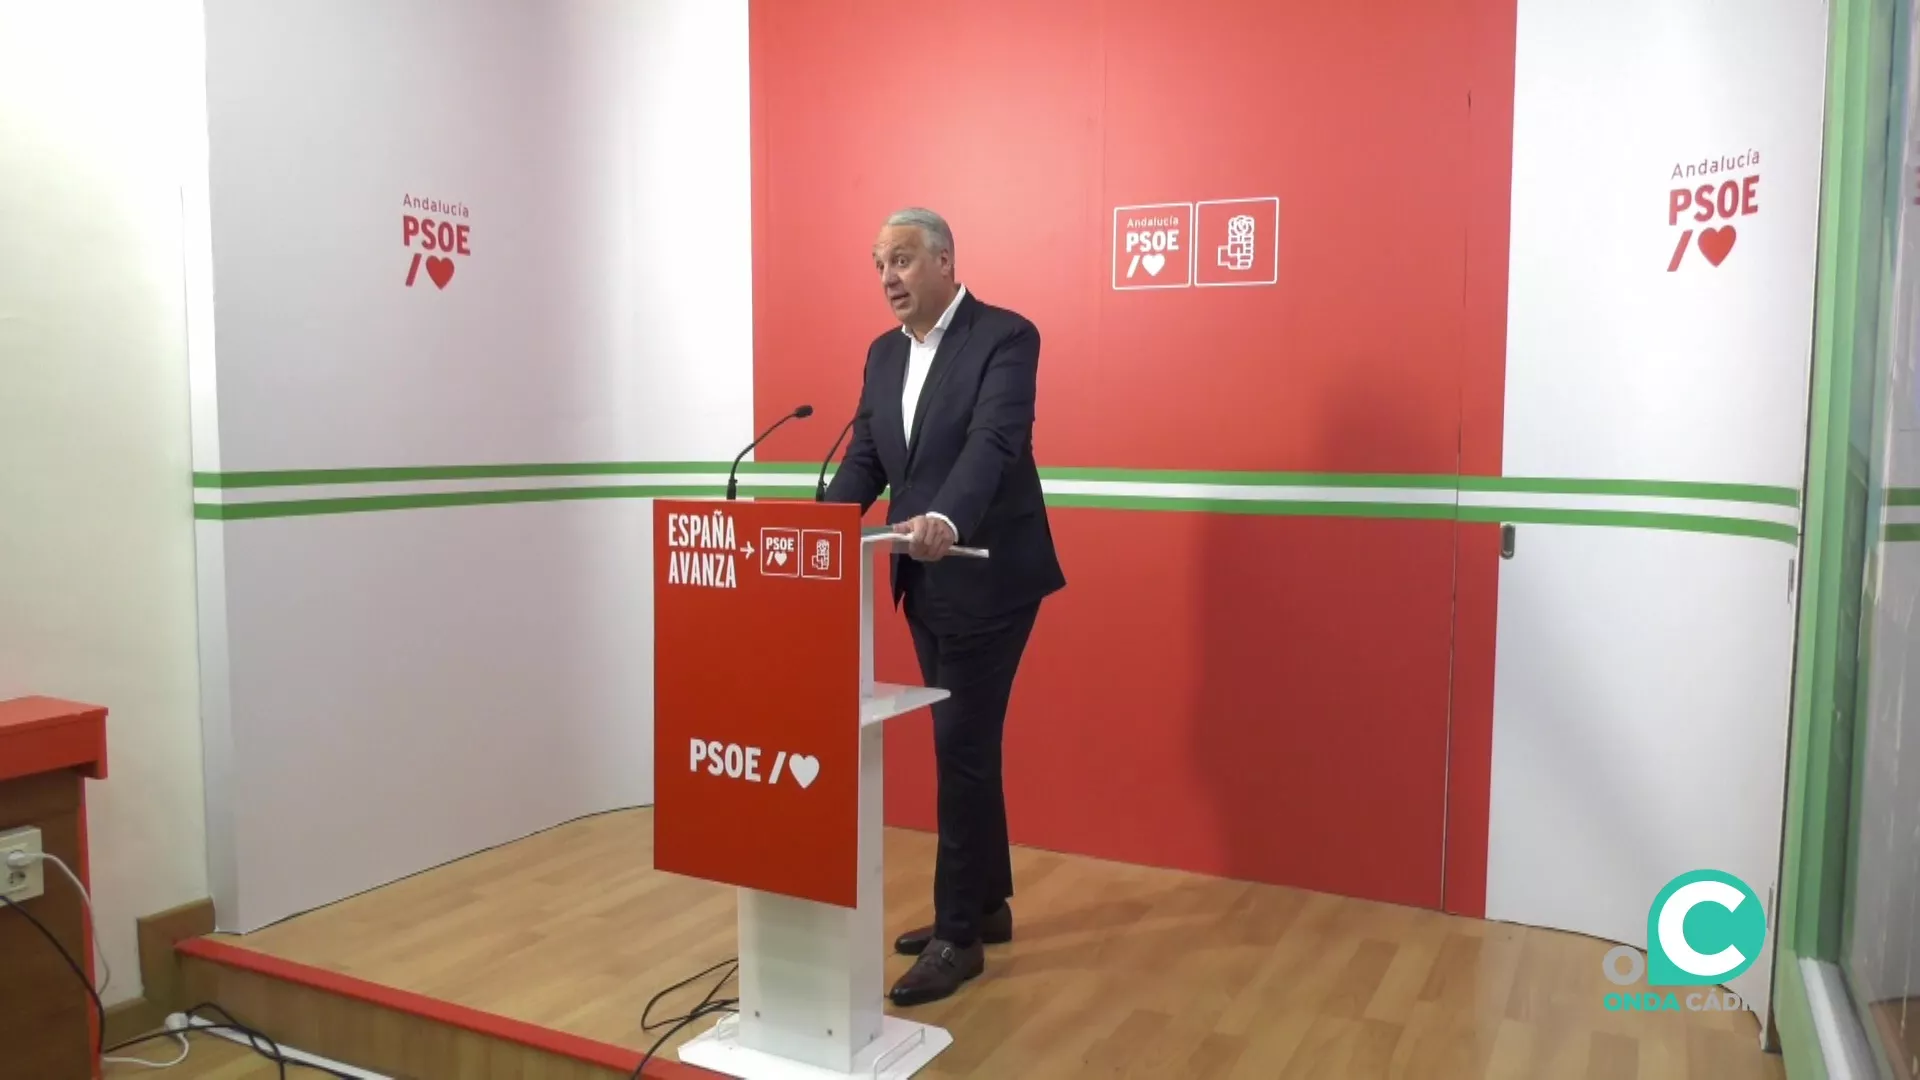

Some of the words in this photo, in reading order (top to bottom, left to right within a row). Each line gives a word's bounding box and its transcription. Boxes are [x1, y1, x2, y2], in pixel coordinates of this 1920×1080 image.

[1671, 148, 1760, 179] Andalucía
[1668, 174, 1760, 226] PSOE
[403, 215, 471, 256] PSOE
[1126, 229, 1180, 253] PSOE
[1127, 215, 1179, 229] Andalucía
[668, 509, 737, 550] ESPAÑA
[766, 536, 795, 552] PSOE
[668, 551, 737, 589] AVANZA
[689, 737, 762, 783] PSOE
